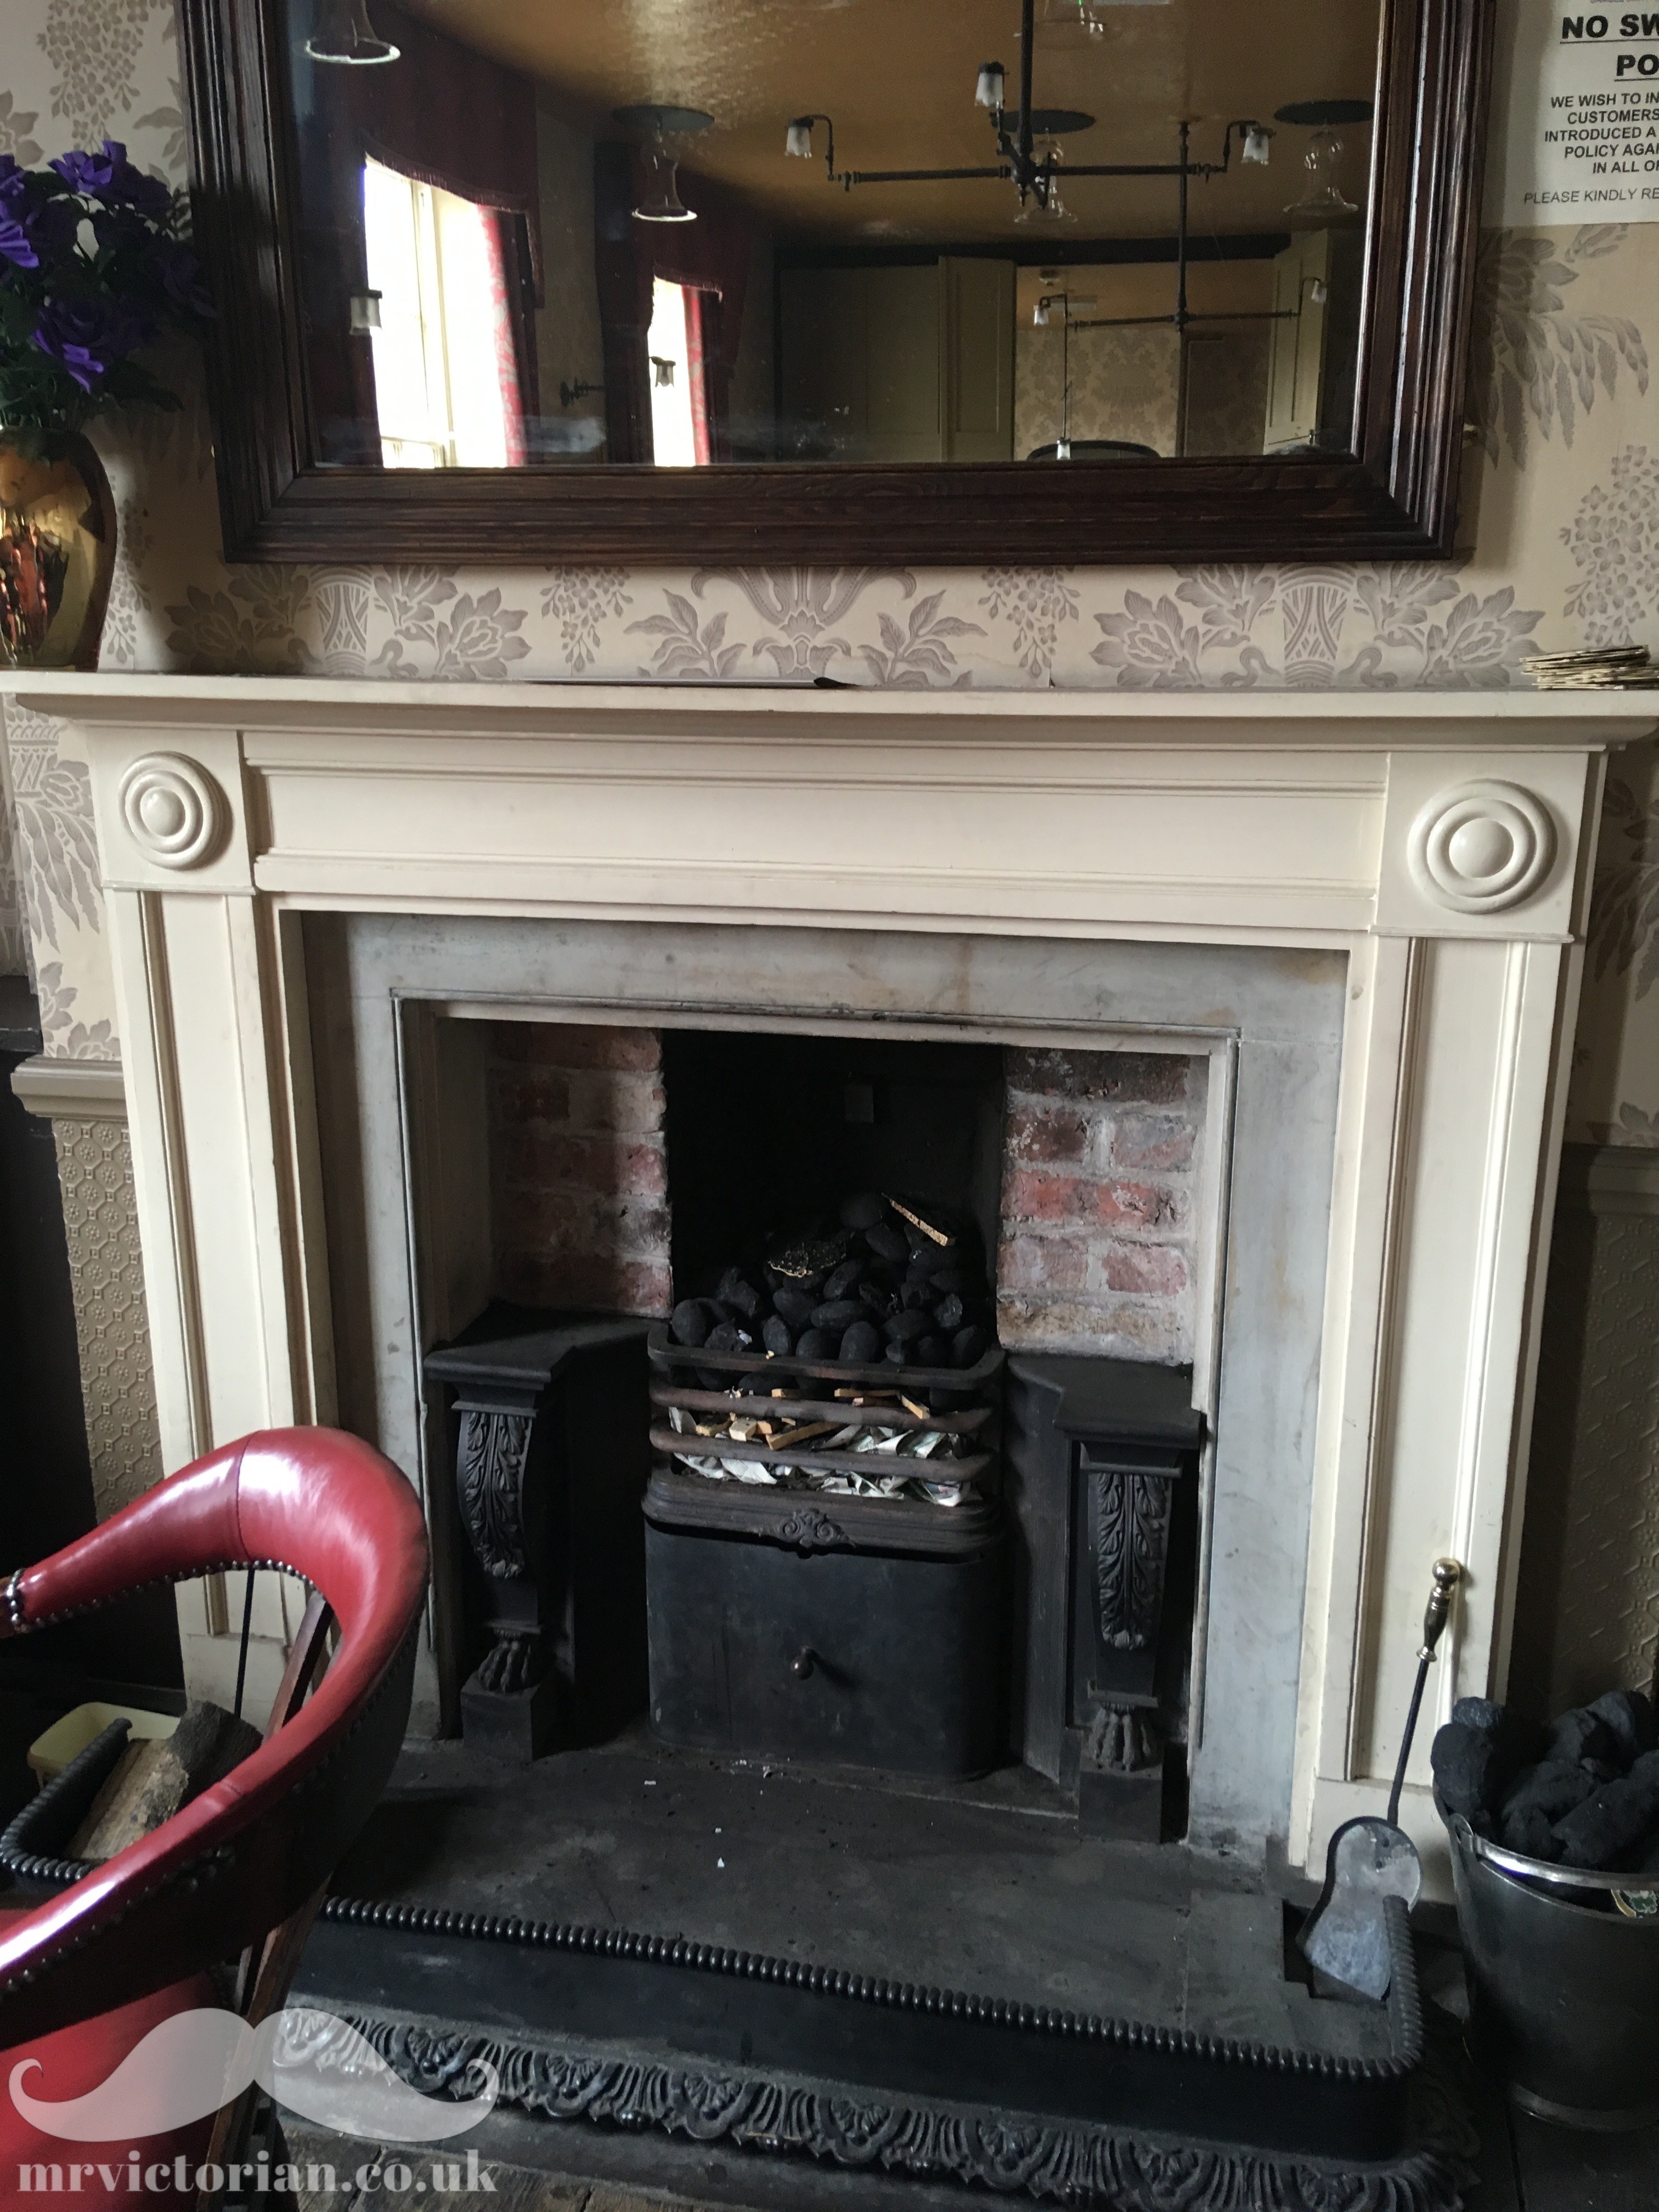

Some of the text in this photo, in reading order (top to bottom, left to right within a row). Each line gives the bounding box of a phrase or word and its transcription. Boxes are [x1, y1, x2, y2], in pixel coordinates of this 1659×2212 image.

[1562, 15, 1609, 39] NO
[1551, 95, 1573, 109] WE
[1579, 93, 1616, 107] WISH
[1621, 92, 1641, 104] TO
[1567, 109, 1659, 125] CUSTOMERS
[1544, 126, 1656, 142] INTRODUCED A
[1565, 144, 1619, 158] POLICY
[1593, 162, 1606, 174] IN
[1611, 160, 1639, 173] ALL
[1524, 190, 1579, 204] PLEASE
[1584, 188, 1638, 202] KINDLY
